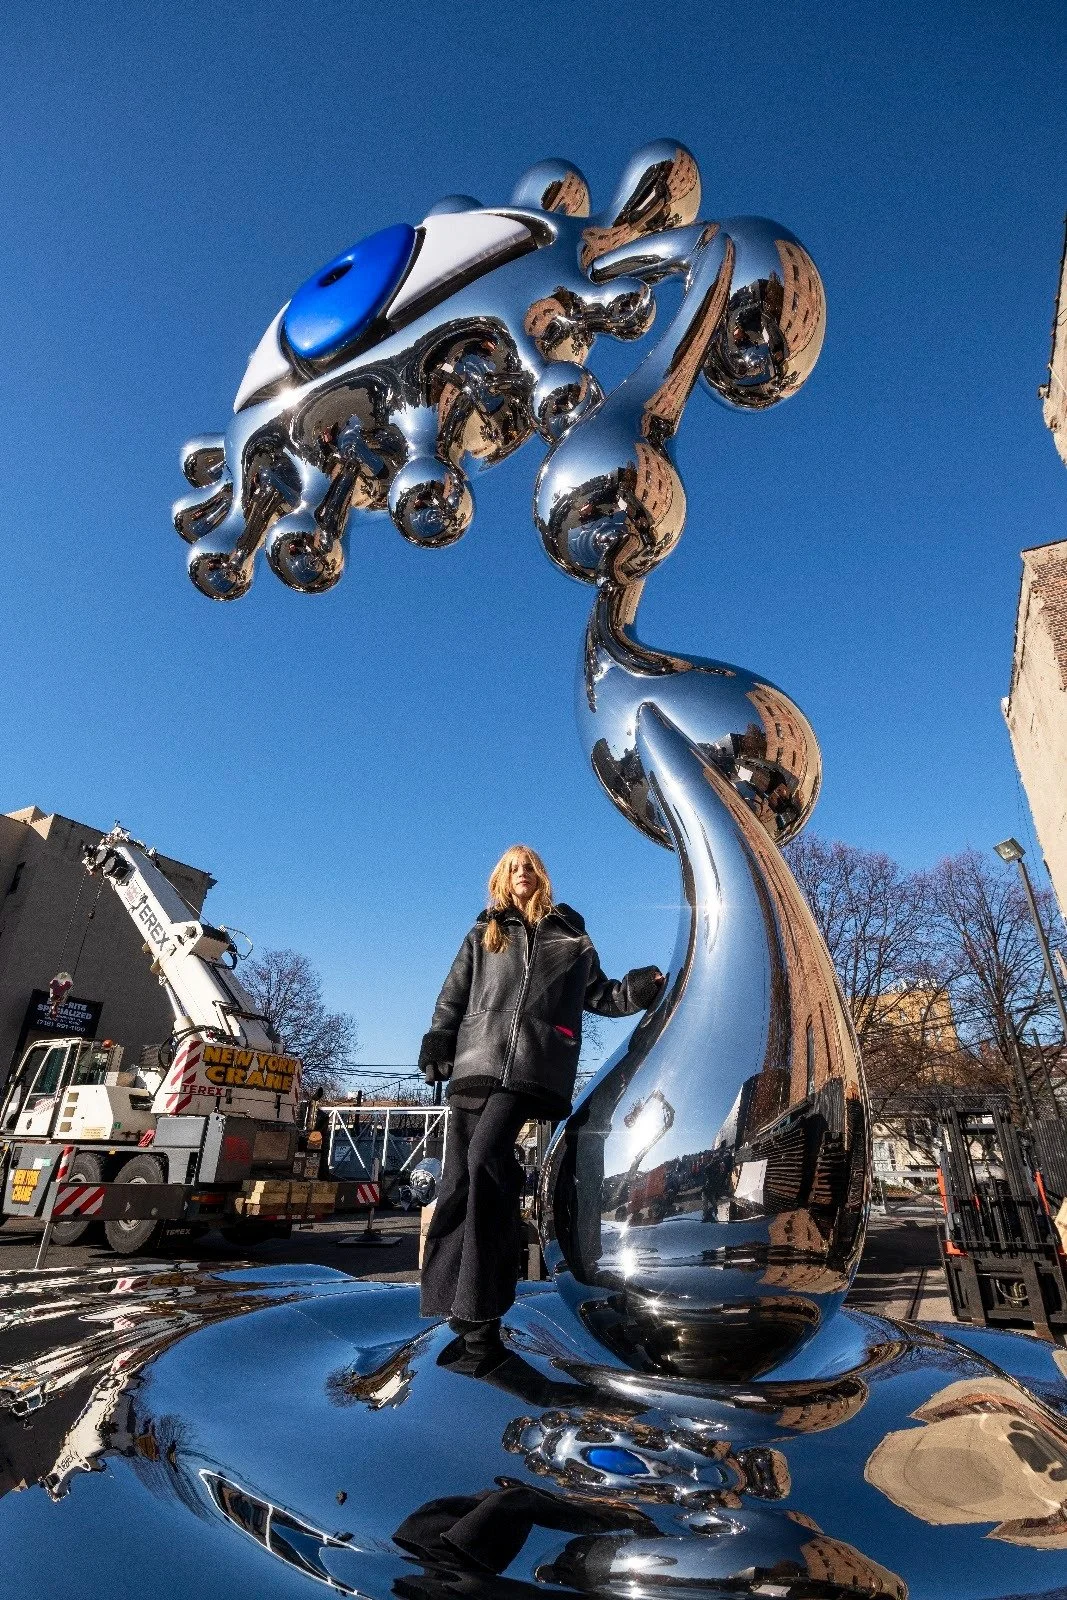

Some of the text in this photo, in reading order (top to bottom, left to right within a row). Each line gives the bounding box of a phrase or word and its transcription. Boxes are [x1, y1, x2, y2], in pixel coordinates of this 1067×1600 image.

[128, 893, 170, 951] TEREX
[37, 1003, 93, 1020] SPIALIZED
[202, 1045, 298, 1075] NEW YORK
[181, 1084, 223, 1096] TEREX
[205, 1065, 294, 1094] CRANE
